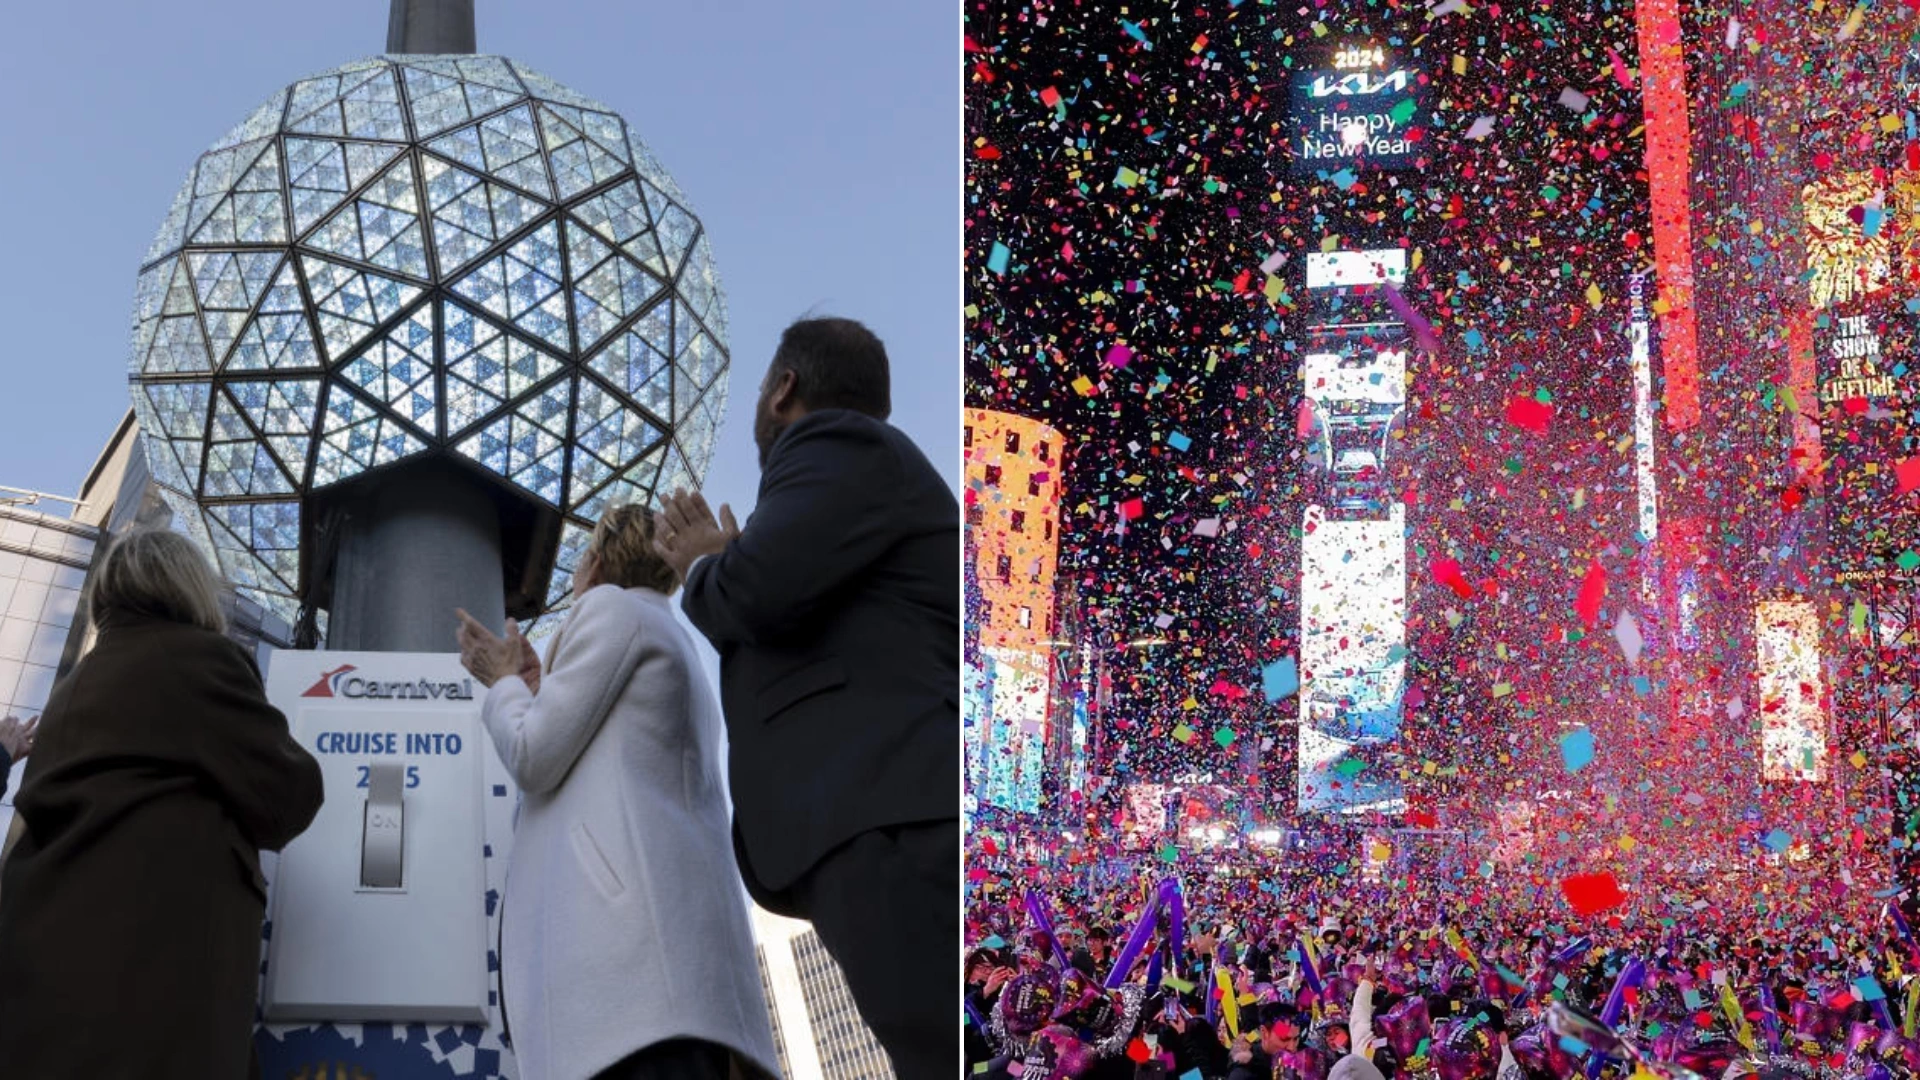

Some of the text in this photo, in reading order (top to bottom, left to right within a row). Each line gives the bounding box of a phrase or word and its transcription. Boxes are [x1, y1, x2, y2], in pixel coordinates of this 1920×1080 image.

[1335, 47, 1385, 68] 2024
[1319, 112, 1396, 134] Happy
[1303, 135, 1412, 159] New Year
[1838, 315, 1871, 337] THE
[1832, 335, 1880, 359] SHOW
[342, 677, 473, 701] Carnival
[316, 732, 462, 755] CRUISE INTO
[356, 766, 420, 788] 25
